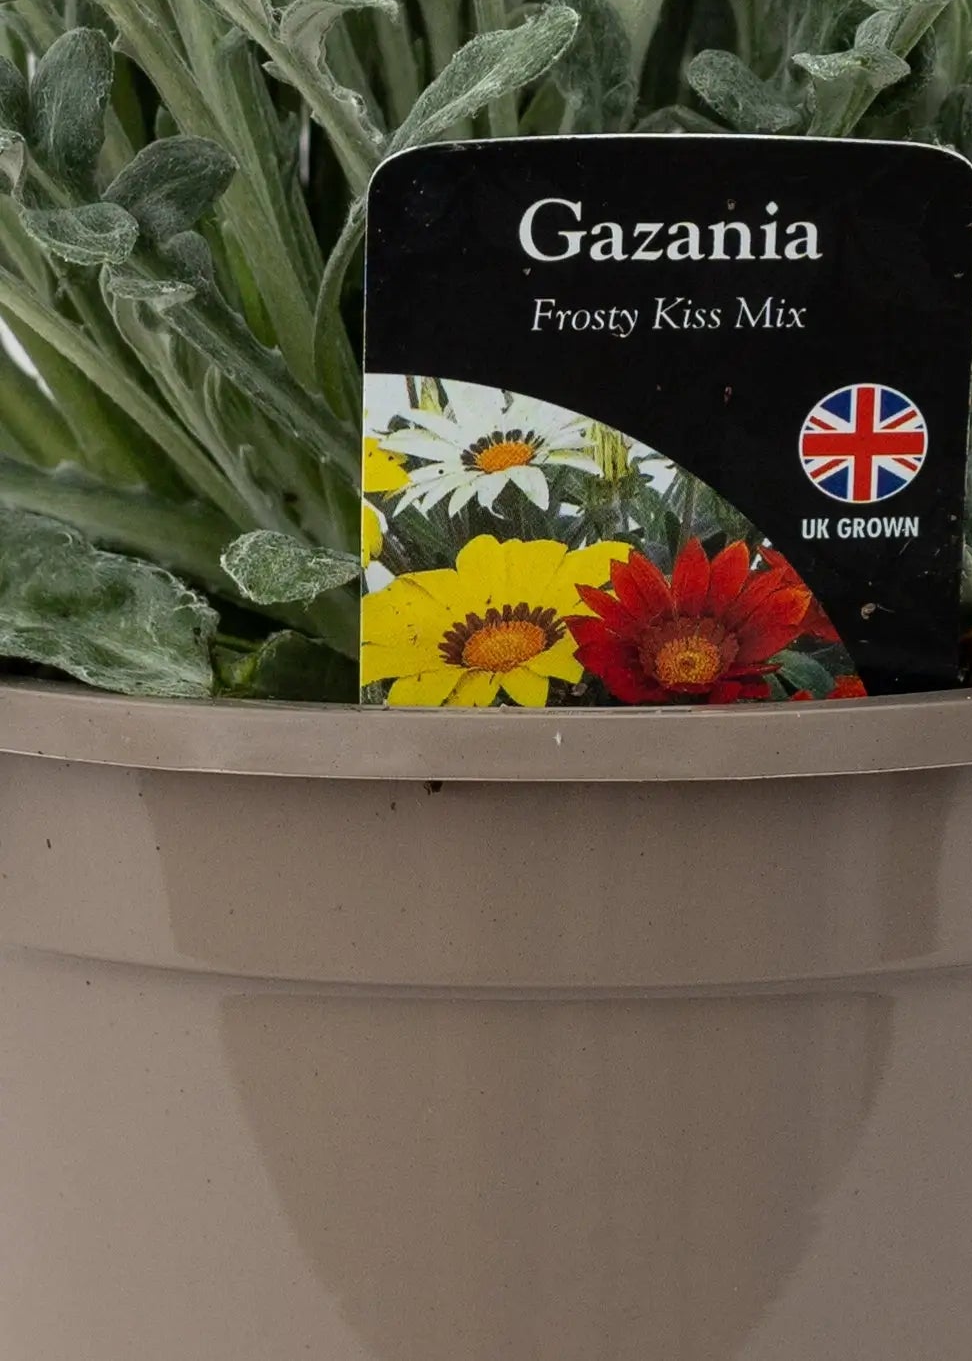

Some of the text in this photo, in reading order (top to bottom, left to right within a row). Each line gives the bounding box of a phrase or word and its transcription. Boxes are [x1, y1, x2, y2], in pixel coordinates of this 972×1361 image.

[518, 197, 823, 262] Gazania
[530, 295, 807, 339] Frosty Kiss Mix
[801, 515, 920, 540] UK GROWN
